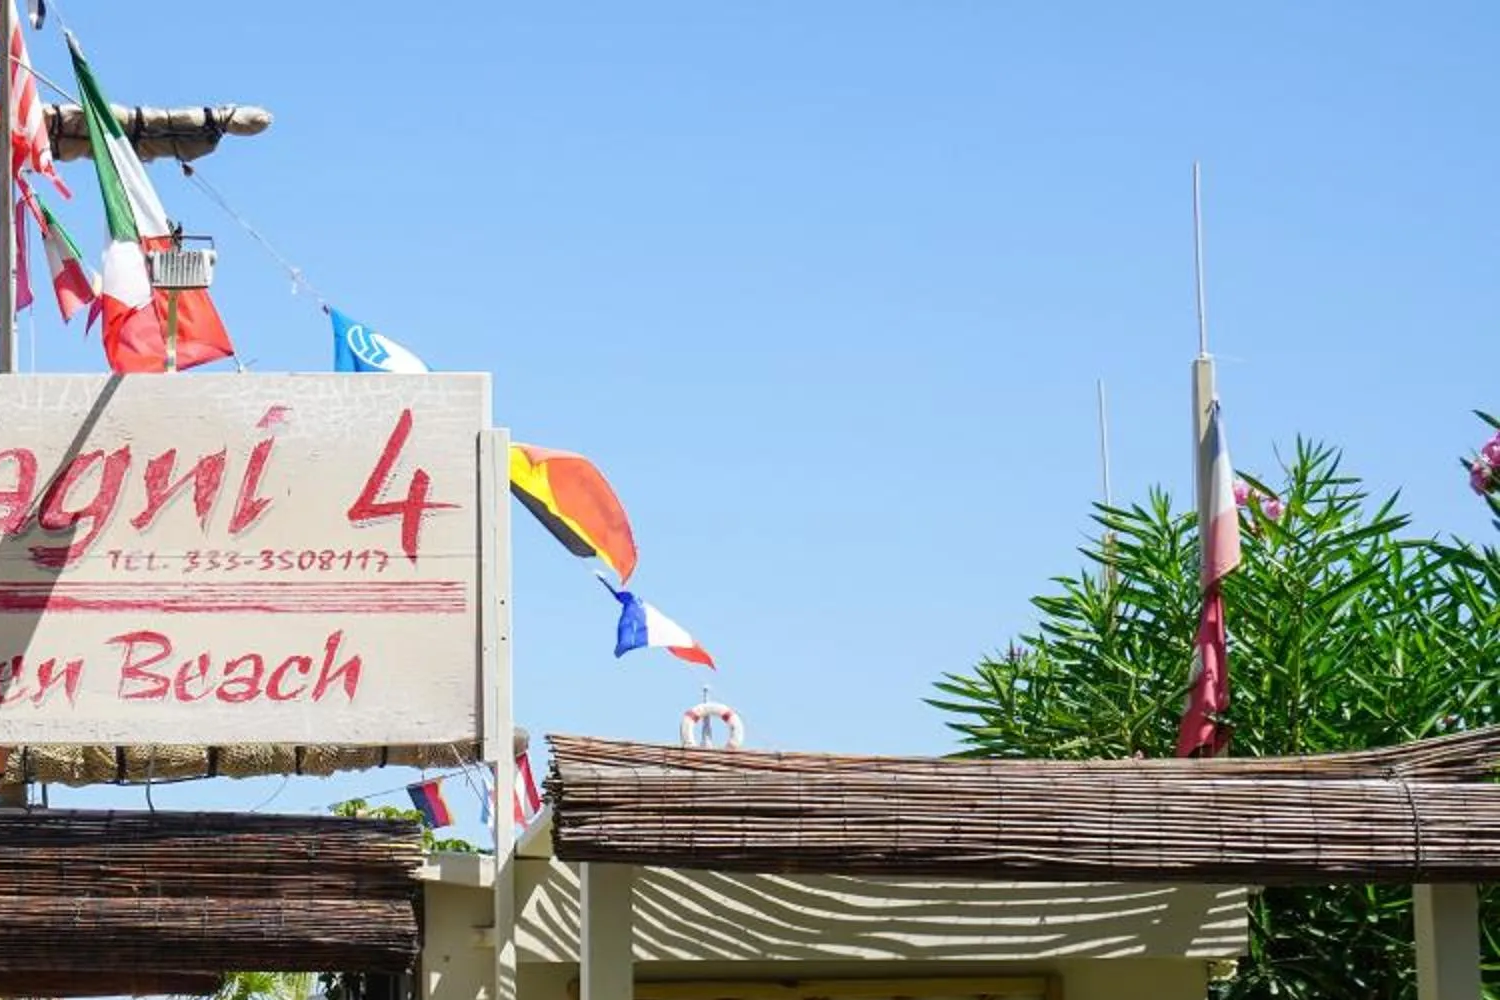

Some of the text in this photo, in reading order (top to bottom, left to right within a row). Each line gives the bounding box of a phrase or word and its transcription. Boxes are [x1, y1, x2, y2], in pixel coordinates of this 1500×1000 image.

[347, 408, 462, 563] 4
[108, 550, 390, 573] TEL. 333-3508117
[104, 628, 363, 704] Beach
